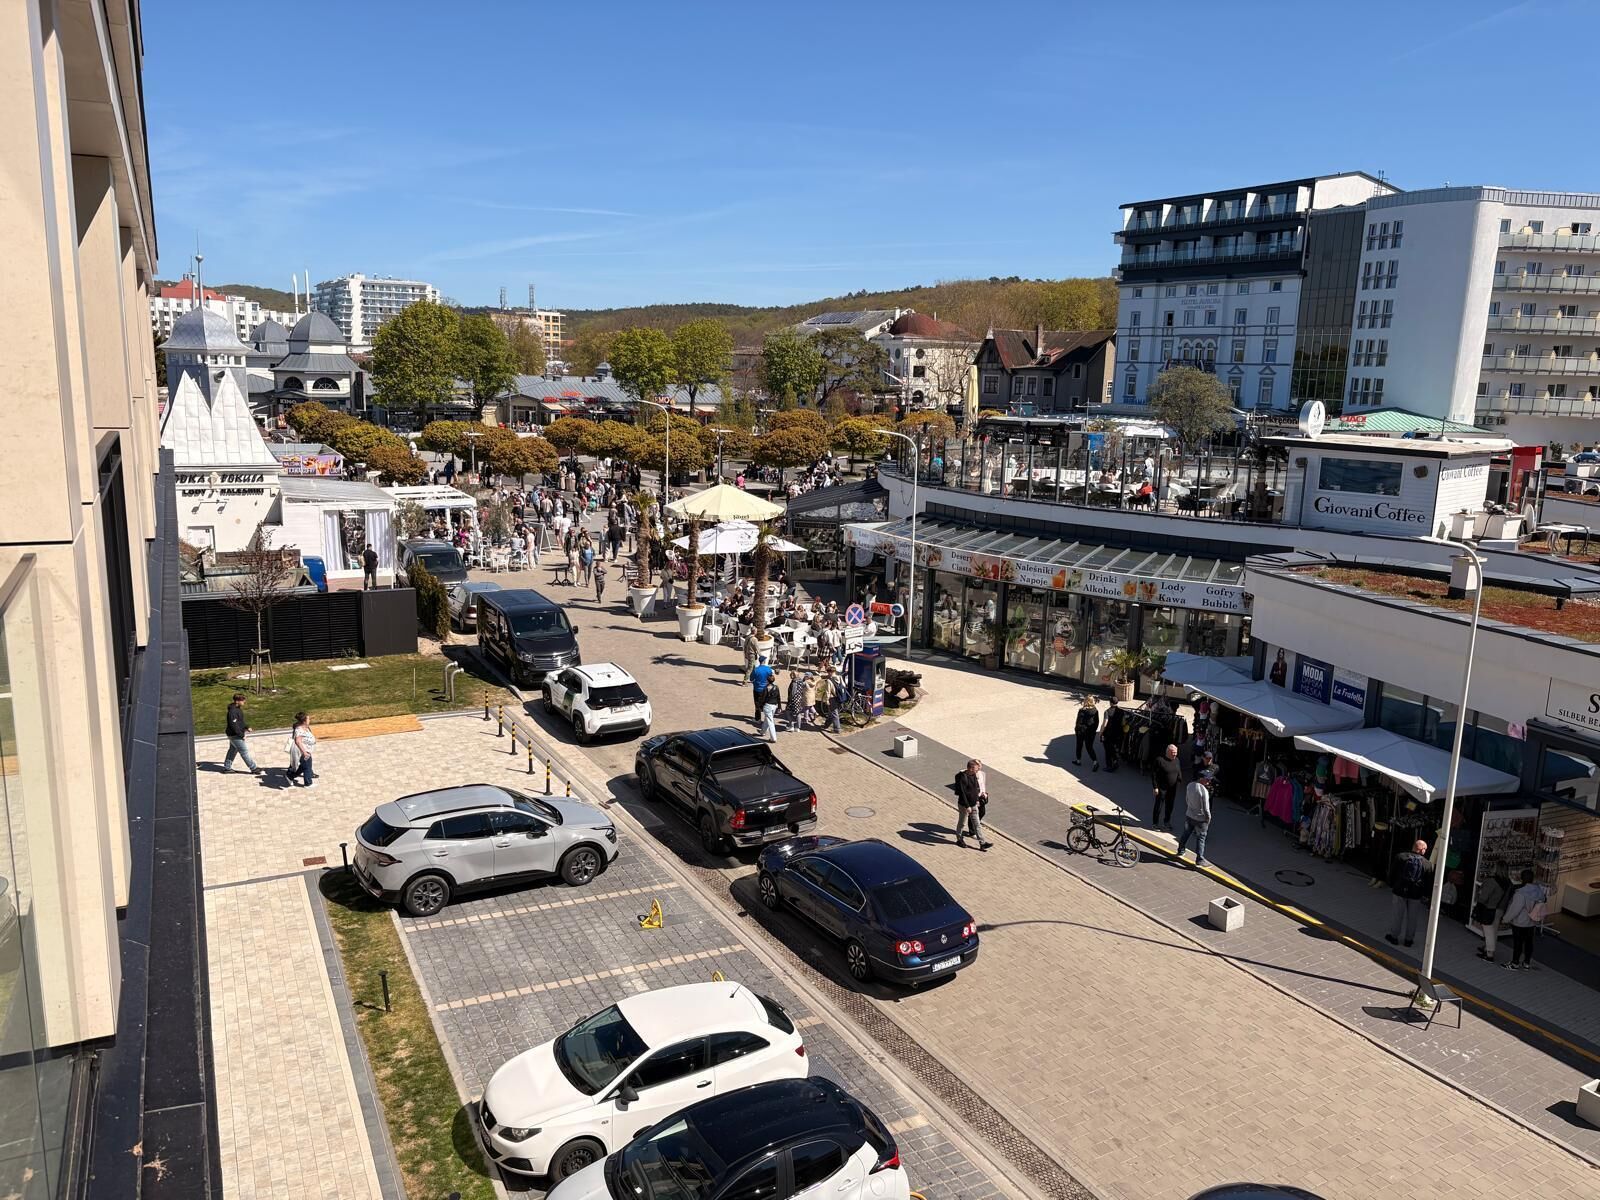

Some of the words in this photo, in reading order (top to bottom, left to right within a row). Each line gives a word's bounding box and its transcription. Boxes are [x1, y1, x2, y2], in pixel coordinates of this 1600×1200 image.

[1269, 415, 1299, 425] kręcon
[1314, 496, 1372, 518] Giovani
[1374, 502, 1426, 523] Coffee
[951, 551, 974, 562] Desery
[951, 563, 972, 573] Ciasta
[1015, 562, 1054, 575] Naleśniki
[1020, 575, 1048, 586] Napoje
[1088, 572, 1118, 584] Drinki
[1083, 583, 1122, 597] Alkohole
[1161, 581, 1187, 593] Lody
[1206, 586, 1236, 599] Gofry
[1158, 593, 1186, 605] Kawa
[1201, 598, 1238, 610] Bubble
[1302, 664, 1324, 682] MODA
[1333, 685, 1341, 695] La
[1558, 708, 1586, 724] SILBER
[1588, 716, 1600, 728] BE
